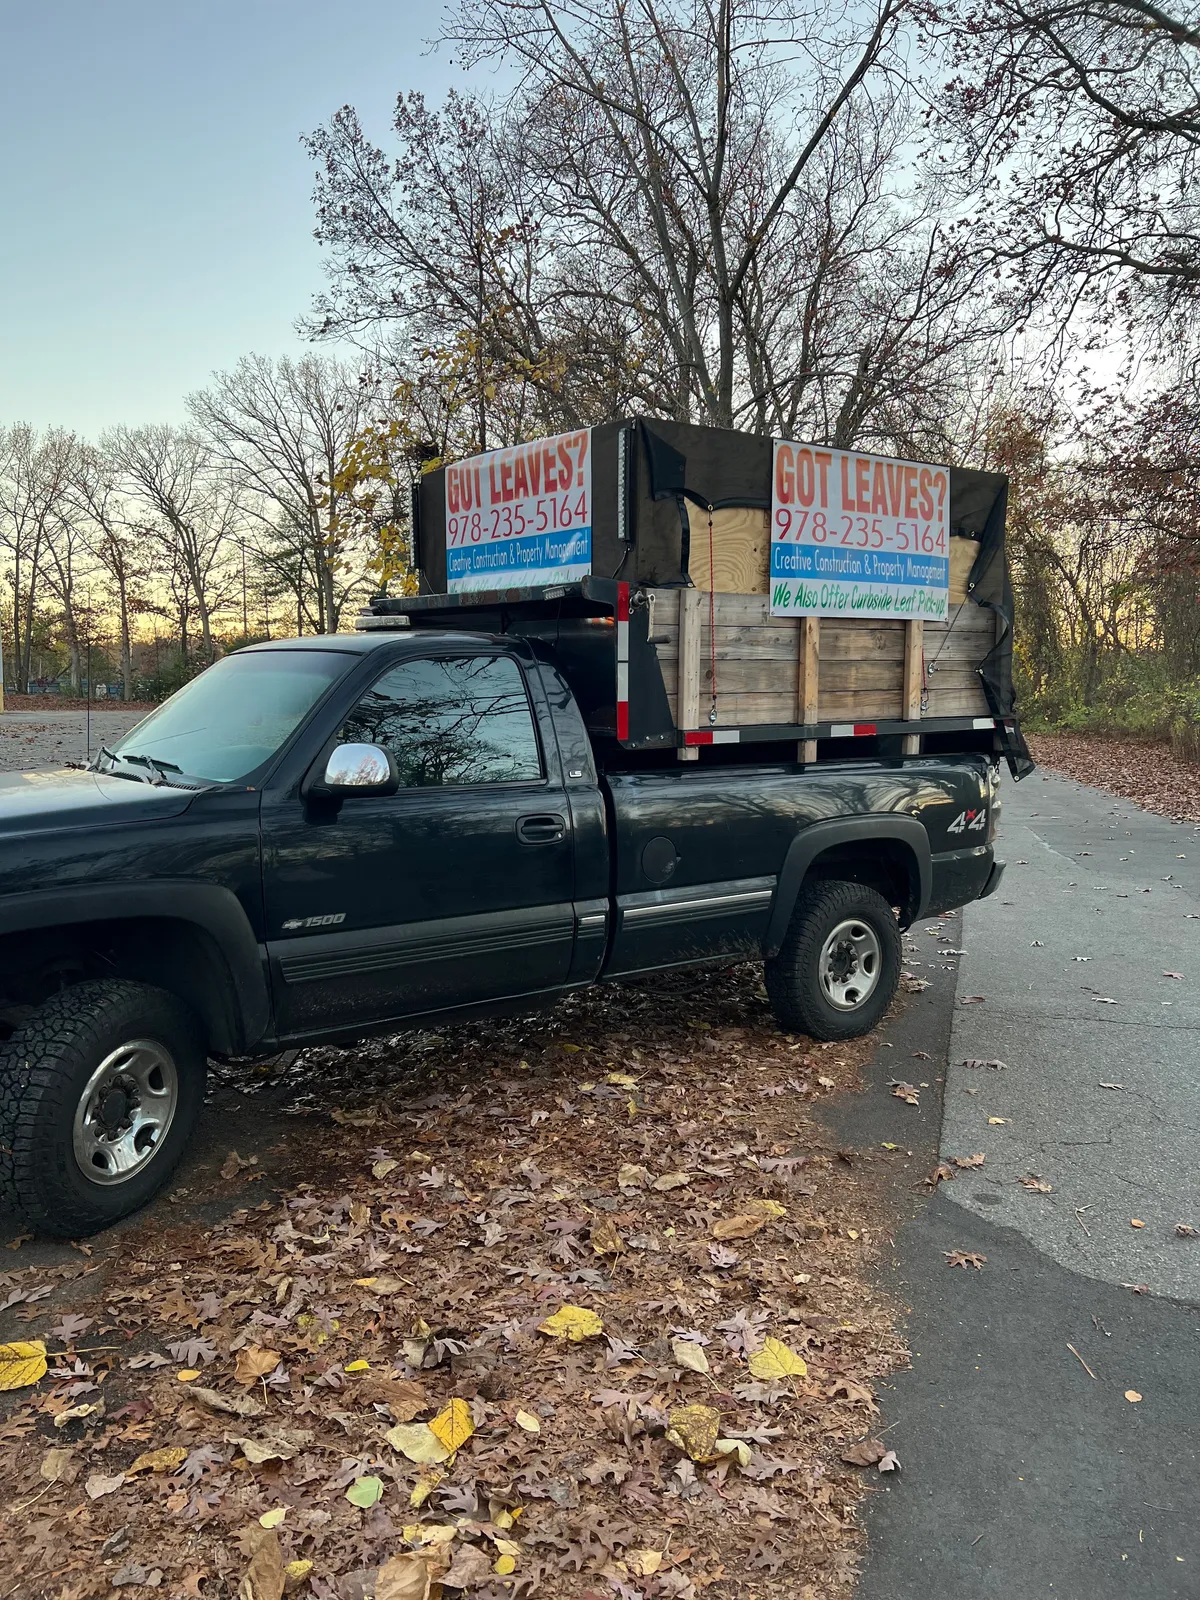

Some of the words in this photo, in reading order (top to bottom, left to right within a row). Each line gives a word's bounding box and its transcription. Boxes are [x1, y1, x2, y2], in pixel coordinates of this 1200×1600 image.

[448, 457, 485, 514] GOT
[489, 431, 589, 505] LEAVES?
[776, 444, 832, 508] GOT
[841, 456, 947, 522] LEAVES?
[448, 491, 588, 546] 978-235-5164
[775, 508, 946, 554] 978-235-5164
[449, 551, 471, 572] Creative
[473, 545, 508, 568] Construction
[509, 543, 515, 564] &
[516, 538, 543, 568] Property
[545, 530, 588, 563] Management
[775, 547, 812, 571] Creative
[814, 549, 862, 574] Construction
[864, 553, 872, 575] &
[873, 555, 905, 582] Property
[907, 557, 946, 584] Management
[772, 581, 792, 608] We
[794, 582, 818, 608] Also
[821, 583, 850, 609] Offer
[851, 585, 892, 611] Curbside
[894, 587, 917, 612] Leaf
[917, 589, 947, 619] Pick-up!
[305, 912, 347, 928] 1500
